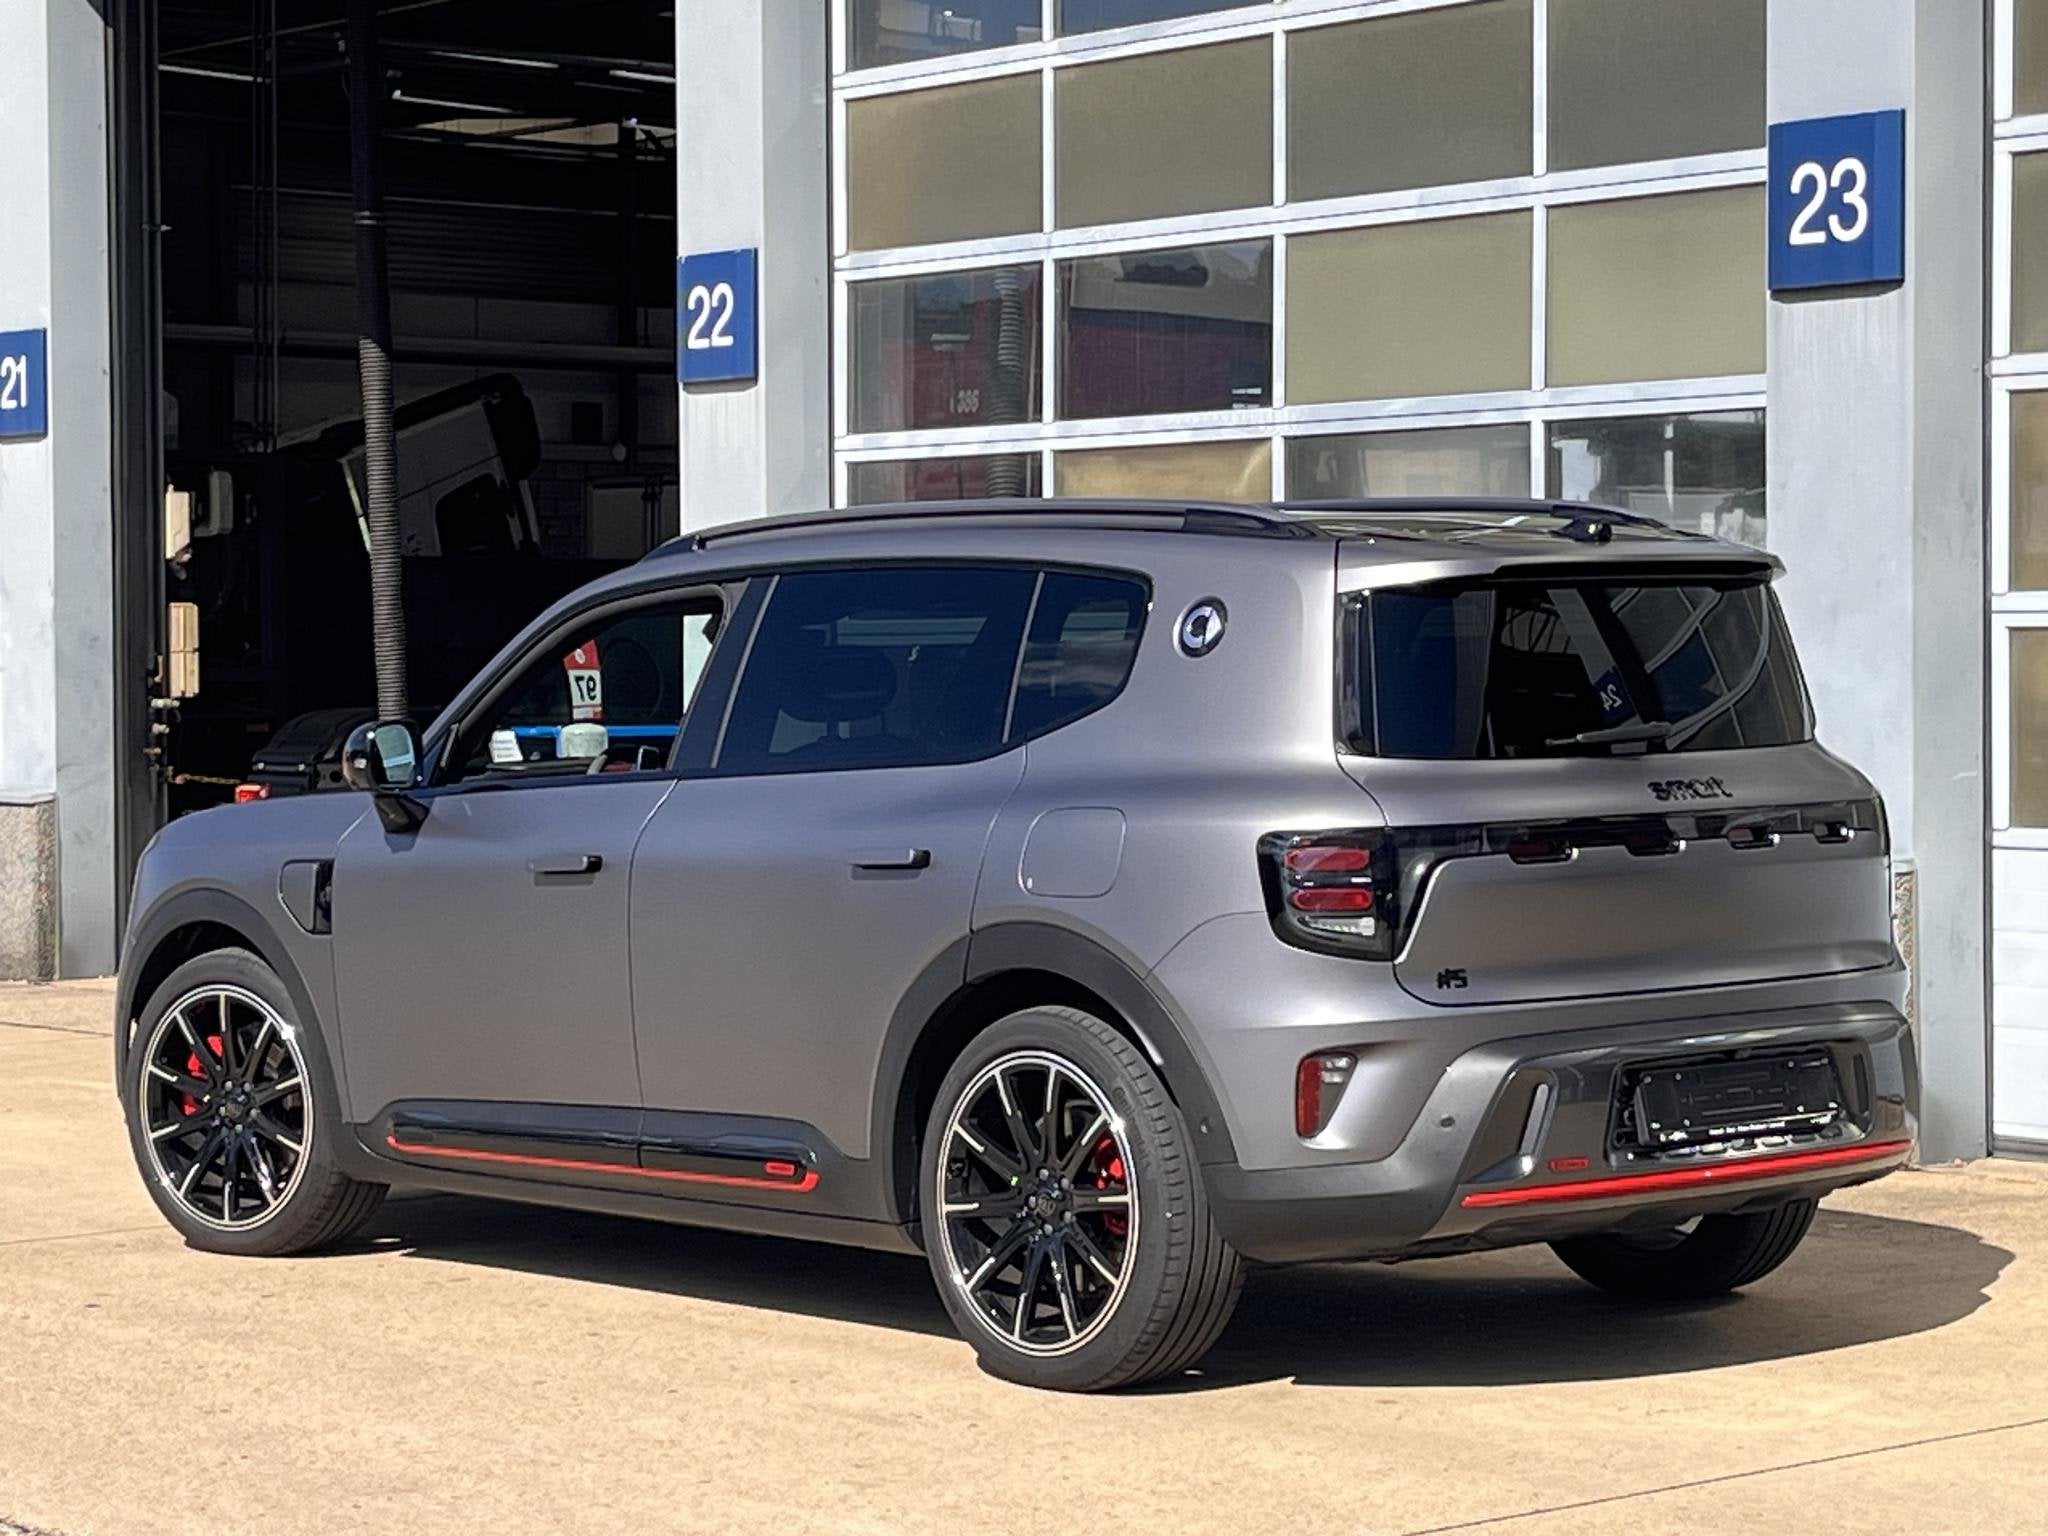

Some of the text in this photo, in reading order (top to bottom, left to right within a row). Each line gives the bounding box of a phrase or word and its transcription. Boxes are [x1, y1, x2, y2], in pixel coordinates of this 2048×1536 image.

[1789, 156, 1868, 246] 23
[687, 282, 734, 349] 22
[0, 355, 27, 409] 21
